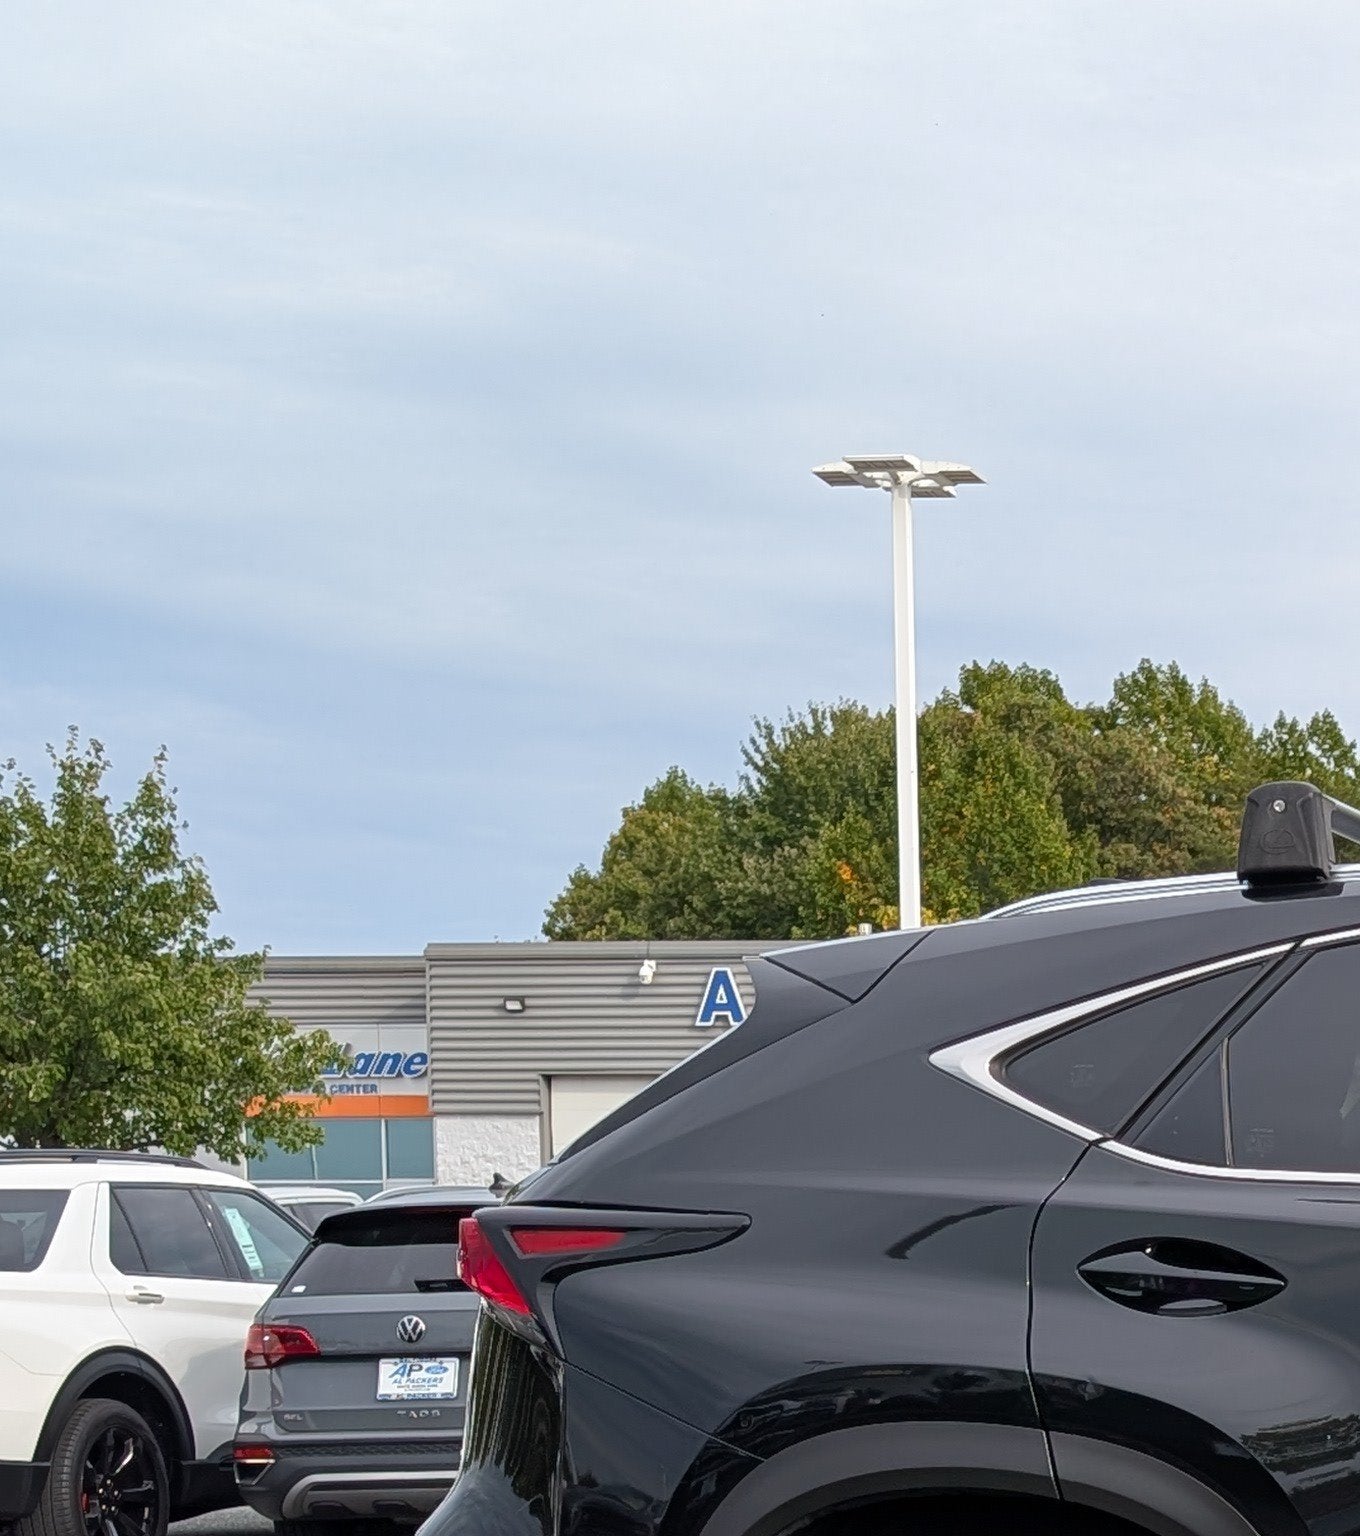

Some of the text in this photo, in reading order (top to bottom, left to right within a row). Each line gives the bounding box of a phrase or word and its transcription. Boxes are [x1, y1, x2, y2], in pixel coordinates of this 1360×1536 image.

[695, 966, 747, 1026] A
[330, 1083, 378, 1095] CENTER
[389, 1363, 423, 1378] AP
